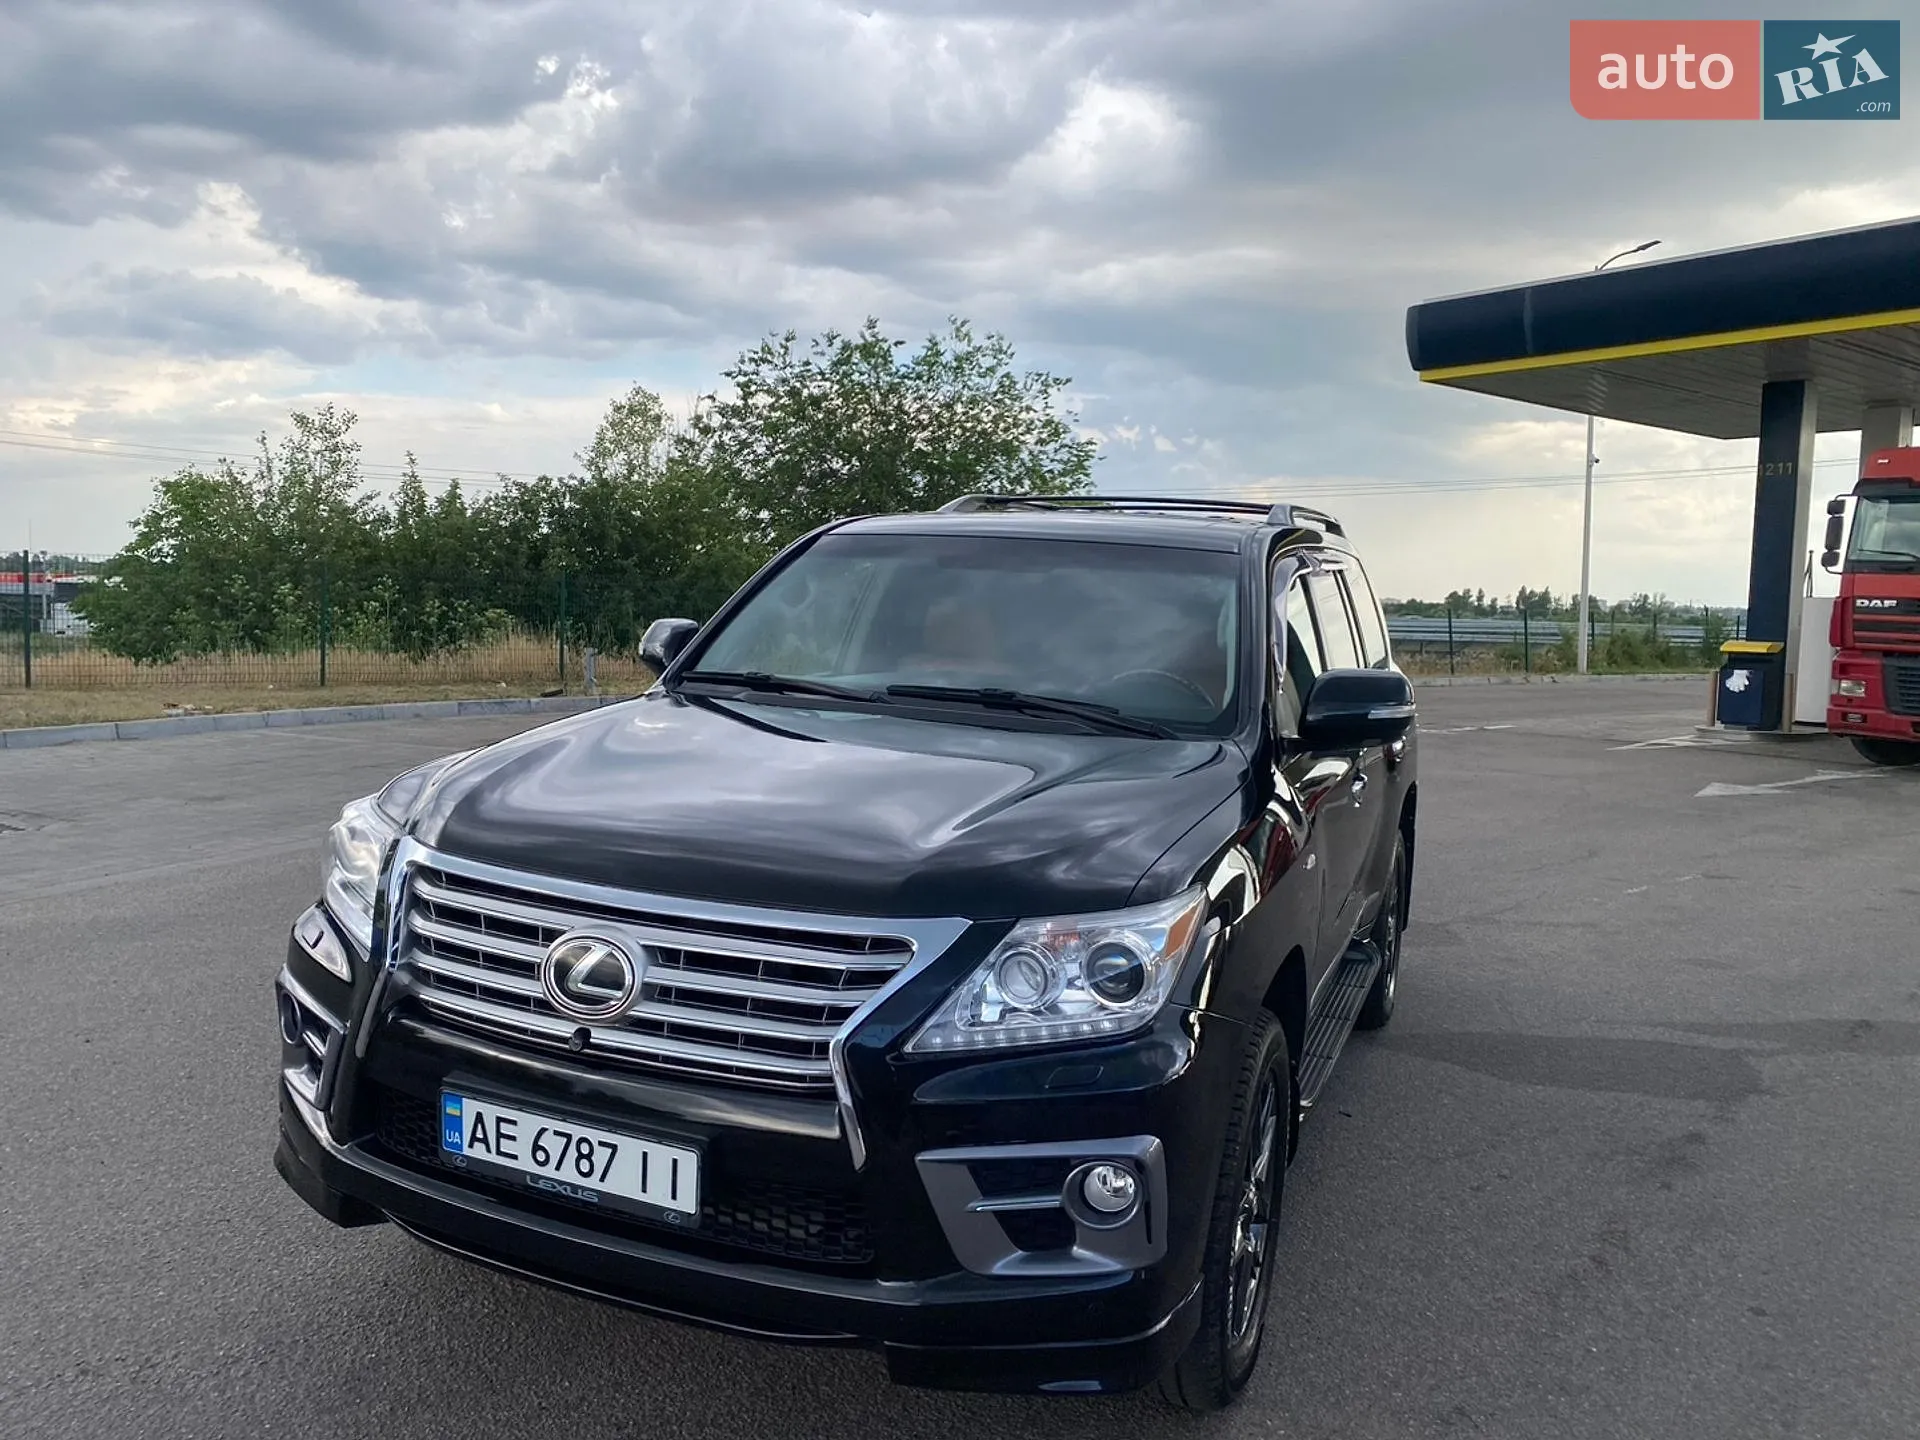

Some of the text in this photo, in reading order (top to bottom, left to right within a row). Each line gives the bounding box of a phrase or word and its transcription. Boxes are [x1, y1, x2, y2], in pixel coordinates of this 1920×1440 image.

[1855, 599, 1898, 607] DAF
[446, 1129, 461, 1145] UA
[467, 1111, 519, 1161] AE
[531, 1127, 619, 1183] 6787
[526, 1175, 599, 1203] LEXUS
